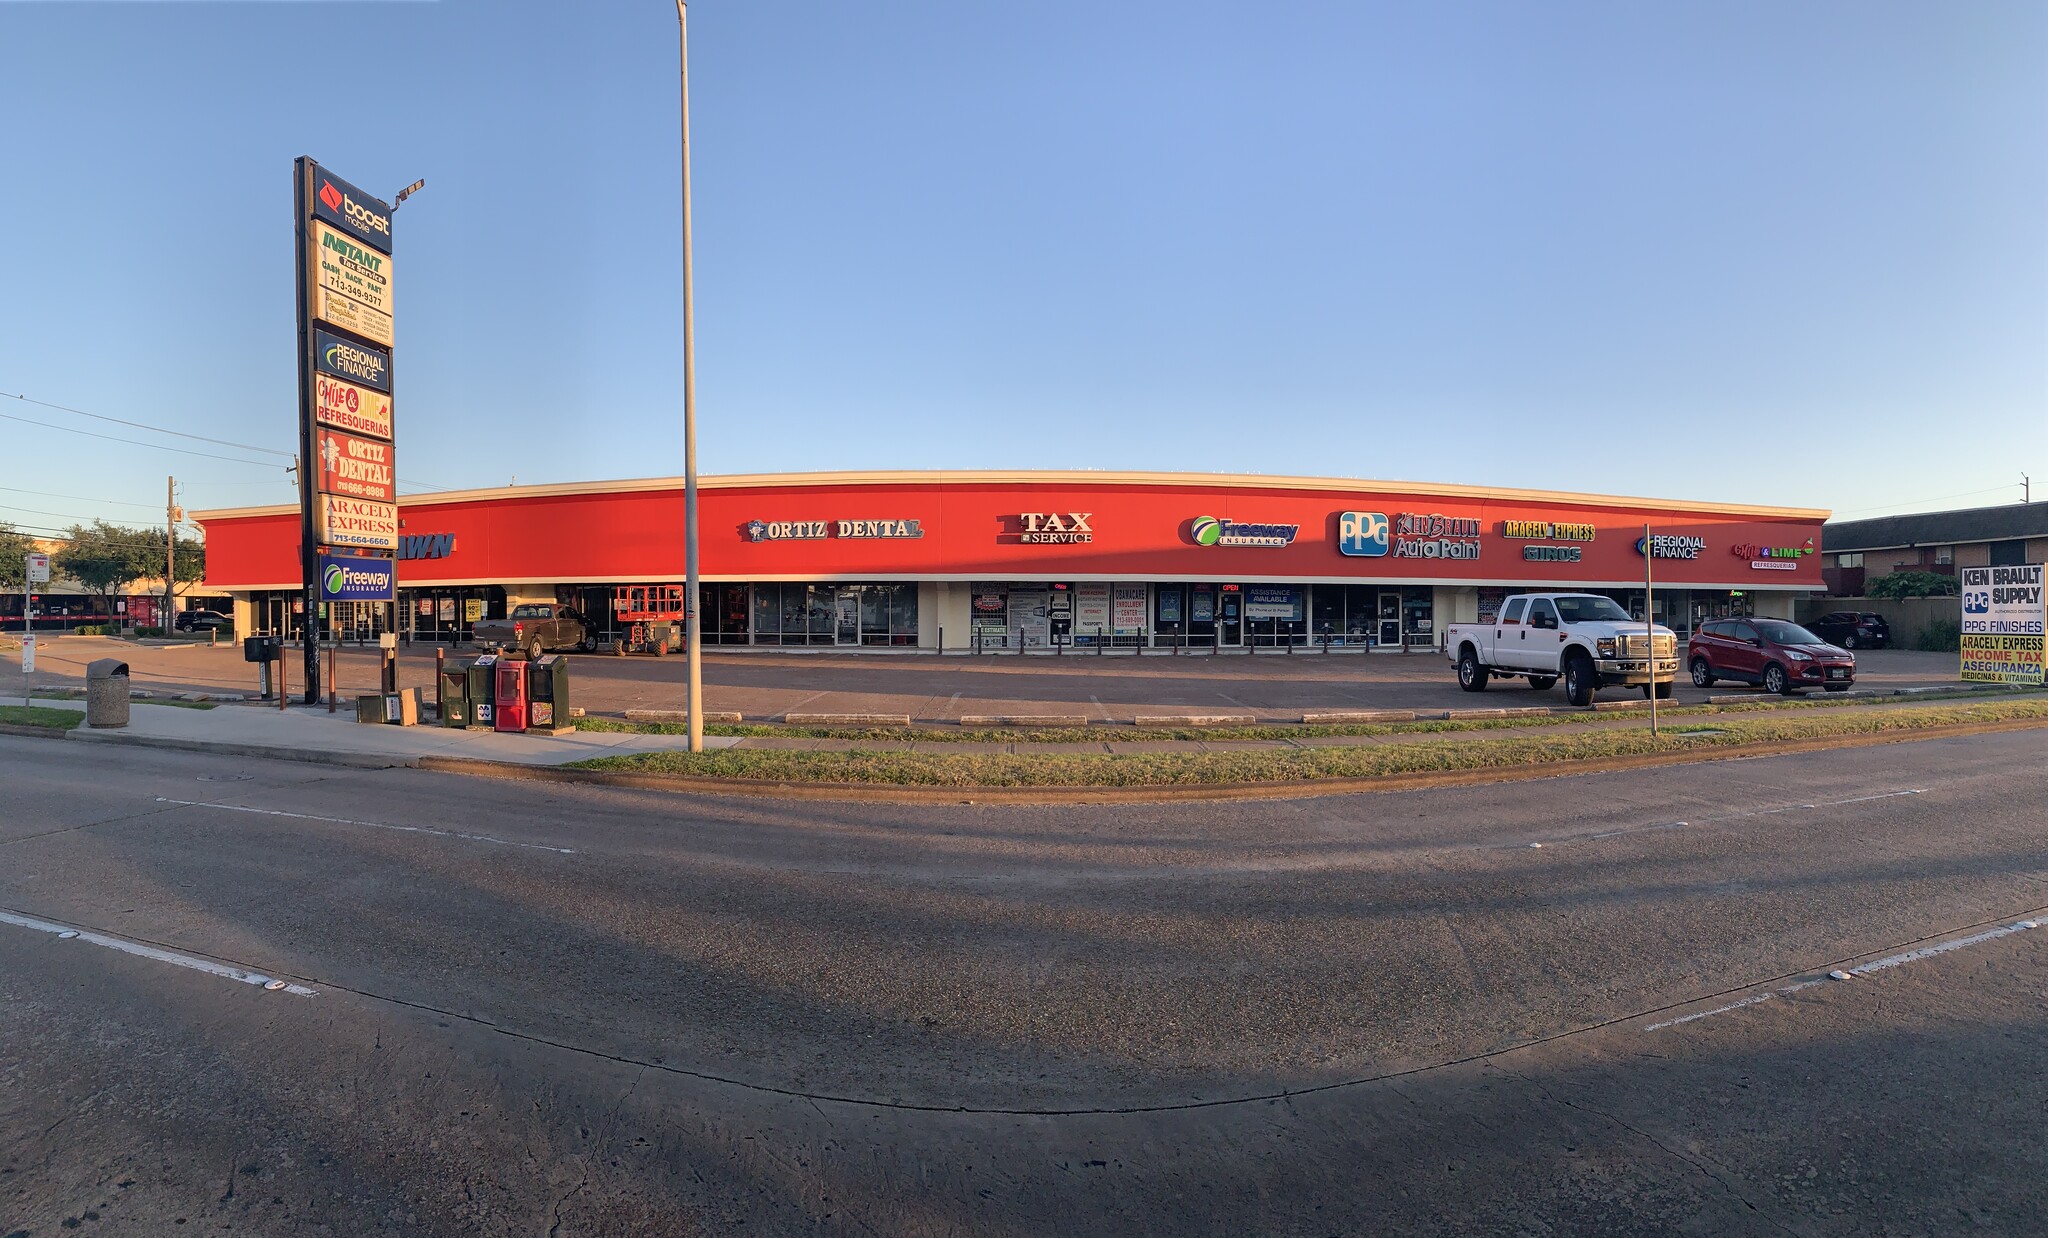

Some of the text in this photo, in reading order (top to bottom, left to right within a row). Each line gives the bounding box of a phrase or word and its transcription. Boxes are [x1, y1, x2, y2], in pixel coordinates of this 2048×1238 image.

[344, 193, 389, 236] boost
[345, 214, 370, 233] mobile
[323, 231, 382, 272] INSTANT
[322, 261, 382, 295] CASH BACK FAST
[342, 257, 383, 284] Tax Service
[330, 276, 382, 306] 713-349-9377
[337, 343, 385, 371] REGIONAL
[337, 357, 378, 382] FINANCE
[360, 390, 380, 420] LIME
[318, 406, 389, 436] REFRESQUERIAS
[348, 438, 385, 463] ORTIZ
[338, 456, 391, 485] DENTAL
[327, 500, 394, 518] ARACELY
[327, 515, 394, 533] EXPRESS
[767, 521, 827, 538] ORTIZ
[1021, 513, 1092, 531] TAX
[1220, 519, 1299, 542] Freeway
[1505, 520, 1595, 541] ARACELY EXPRESS
[1032, 533, 1092, 543] SERVICE
[1221, 537, 1285, 545] INSURANCE
[1653, 535, 1706, 549] REGIONAL
[1394, 537, 1481, 560] Auto Paint
[1524, 545, 1582, 562] GIROS
[1653, 546, 1698, 559] FINANCE
[1771, 548, 1802, 558] LIME
[1753, 561, 1795, 569] REFRESQUERIAS
[342, 567, 390, 589] Freeway
[1964, 567, 2042, 585] KEN BRAULT
[1992, 587, 2041, 604] SUPPLY
[1964, 620, 2042, 633] PPG FINISHES
[1962, 637, 2044, 651] ARACELY EXPRESS
[1962, 650, 2043, 663] INCOME TAX
[1963, 661, 2042, 674] ASEGURANZA
[1961, 671, 2042, 684] MEDICINAS & VITAMINAS
